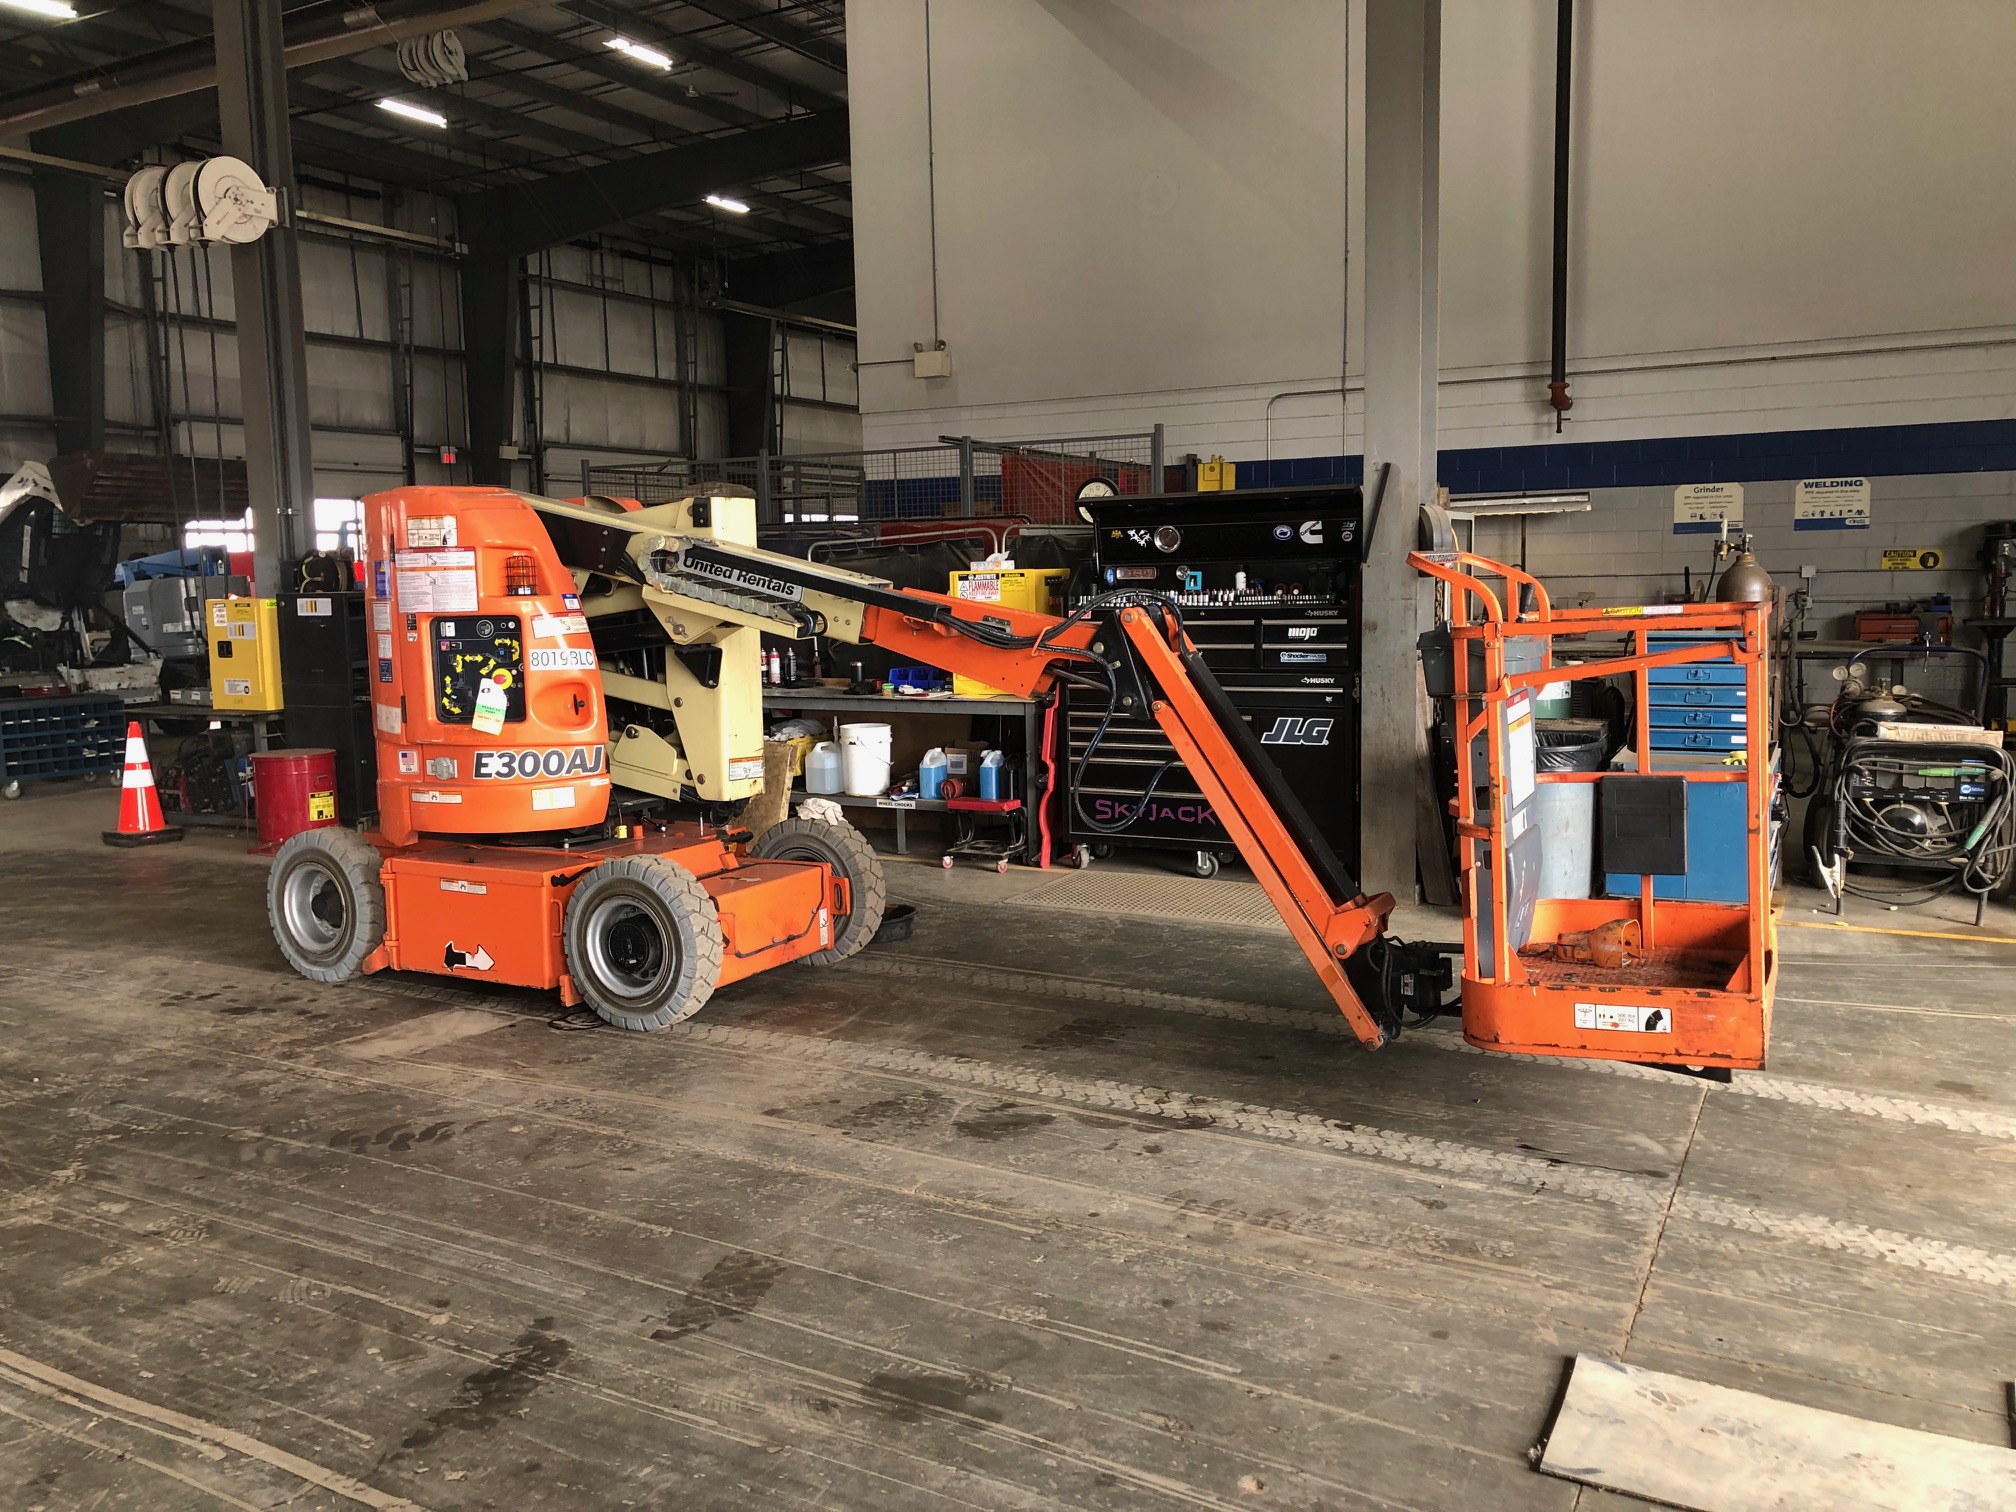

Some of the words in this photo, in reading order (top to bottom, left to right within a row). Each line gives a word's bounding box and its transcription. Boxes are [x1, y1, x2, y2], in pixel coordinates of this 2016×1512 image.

[1804, 480, 1864, 488] WELDING
[683, 557, 733, 579] United
[737, 570, 795, 595] Rentals
[968, 581, 999, 591] FLAMMABLE
[531, 651, 593, 666] 8019BLC
[1261, 717, 1334, 745] JLG
[474, 746, 604, 779] E300AJ
